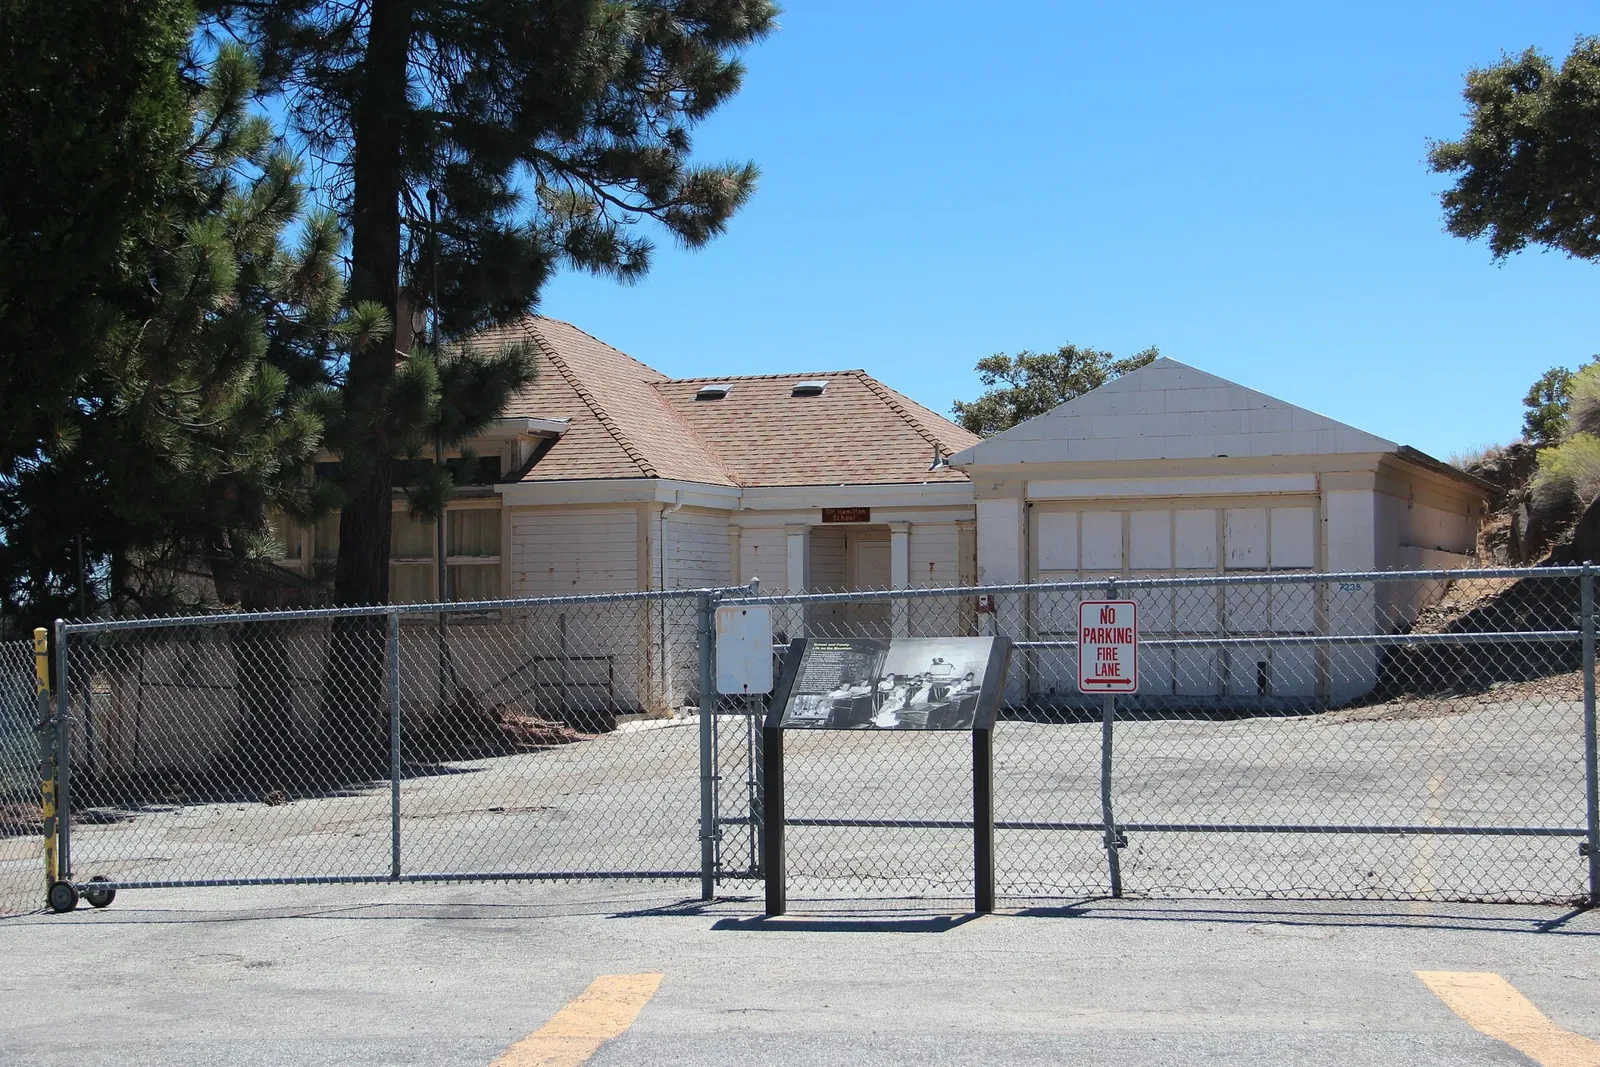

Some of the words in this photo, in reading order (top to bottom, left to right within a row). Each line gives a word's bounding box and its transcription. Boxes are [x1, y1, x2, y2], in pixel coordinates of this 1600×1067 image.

[1339, 583, 1361, 591] 7235
[1100, 607, 1116, 625] NO
[1083, 627, 1132, 644] PARKING
[1097, 647, 1118, 661] FIRE
[1095, 662, 1120, 676] LANE
